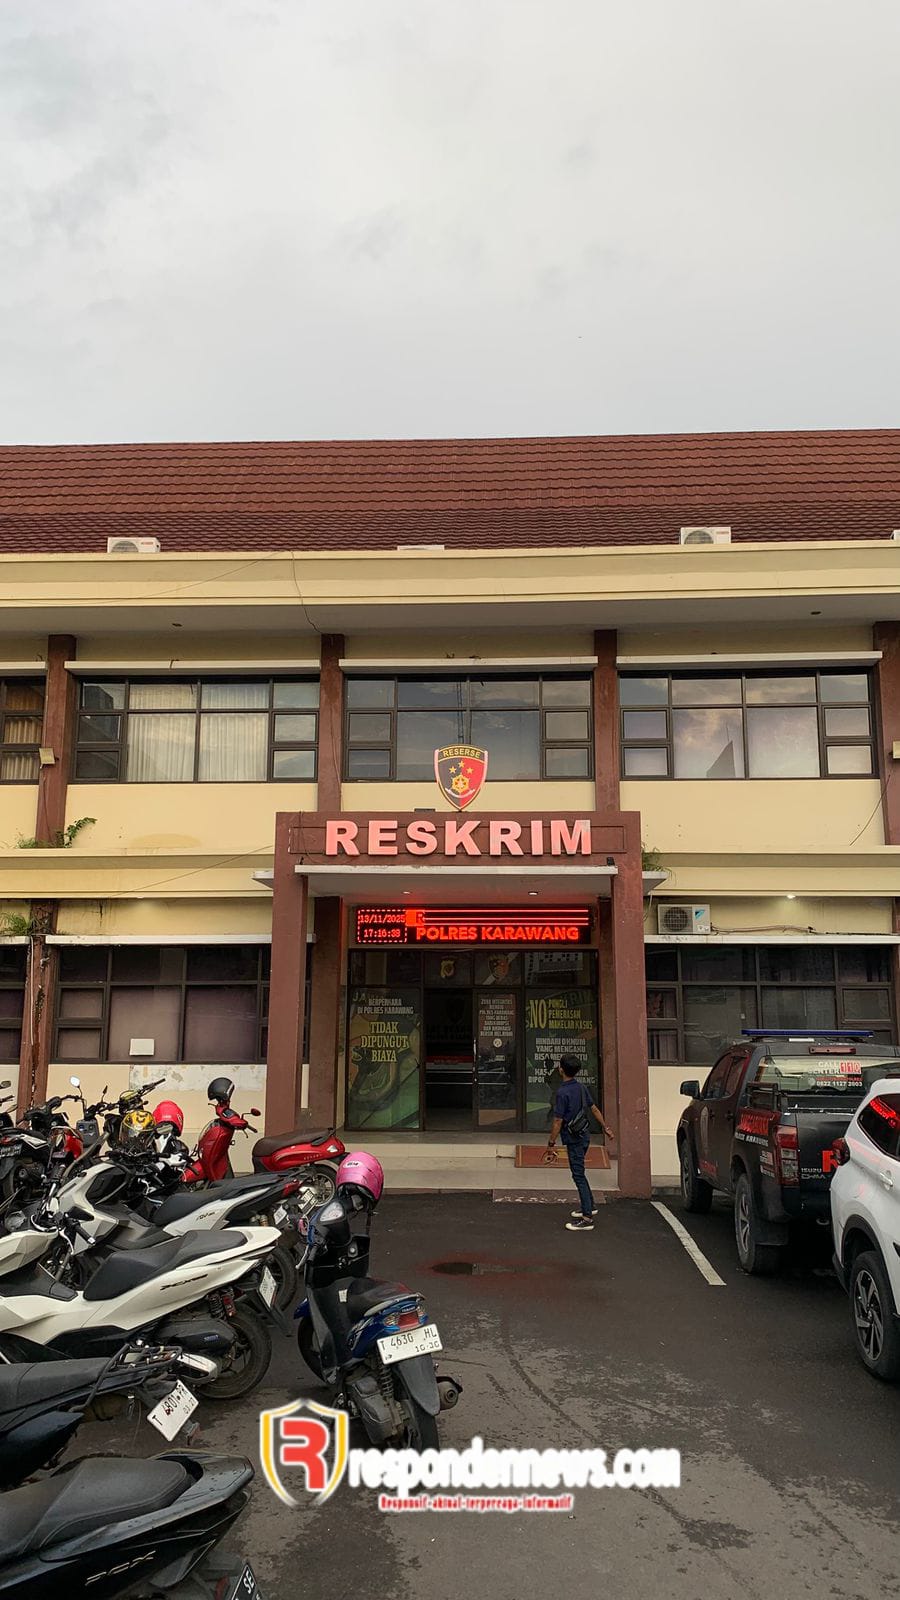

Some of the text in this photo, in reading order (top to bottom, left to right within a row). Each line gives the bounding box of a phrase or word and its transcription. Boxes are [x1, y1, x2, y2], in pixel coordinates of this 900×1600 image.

[442, 748, 481, 758] RESERSE
[325, 820, 592, 856] RESKRIM
[360, 914, 405, 923] 13/11/2025
[416, 926, 579, 940] POLRES KARAWANG
[529, 999, 547, 1029] NO
[370, 1021, 398, 1034] TIDAK
[360, 1035, 408, 1048] DIPUNGUT
[371, 1050, 398, 1063] BIAYA
[840, 1061, 861, 1073] 110
[151, 1414, 163, 1426] T
